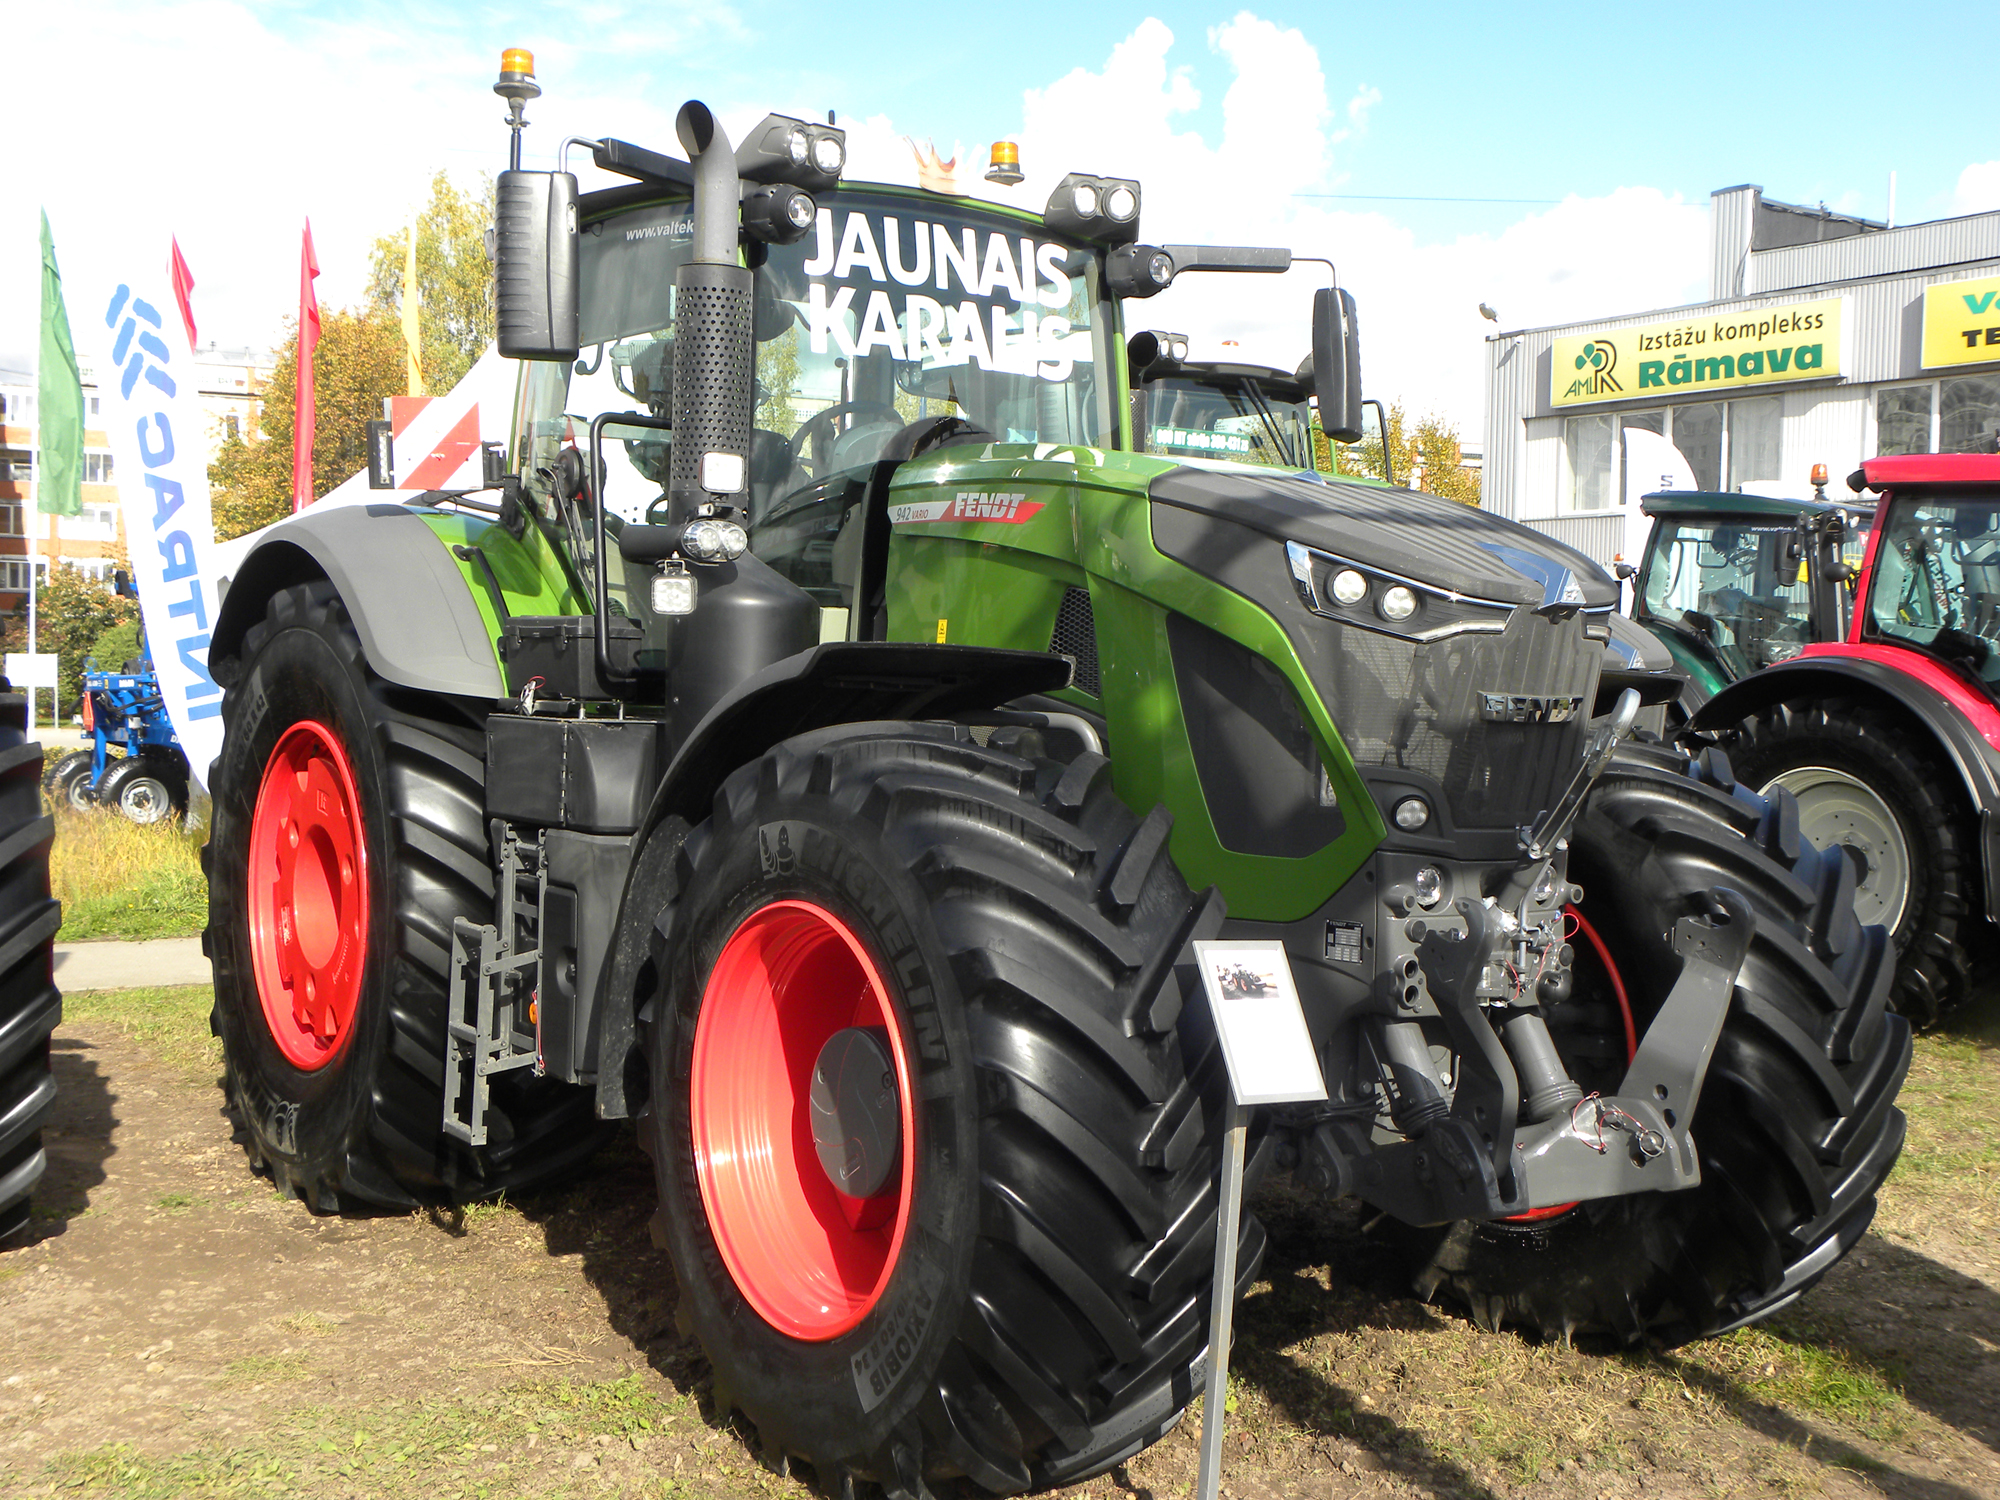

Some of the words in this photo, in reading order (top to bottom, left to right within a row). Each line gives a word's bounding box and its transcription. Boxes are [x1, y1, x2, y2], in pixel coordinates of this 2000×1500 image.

[803, 207, 1072, 309] JAUNAIS
[1962, 290, 2000, 315] V
[808, 283, 1073, 382] KARALIS
[1639, 326, 1707, 351] Izstāžu
[1715, 312, 1824, 341] komplekss
[1639, 343, 1824, 389] Rāmava
[896, 507, 911, 521] 942
[912, 509, 929, 520] VARIO
[954, 492, 1026, 519] FENDT
